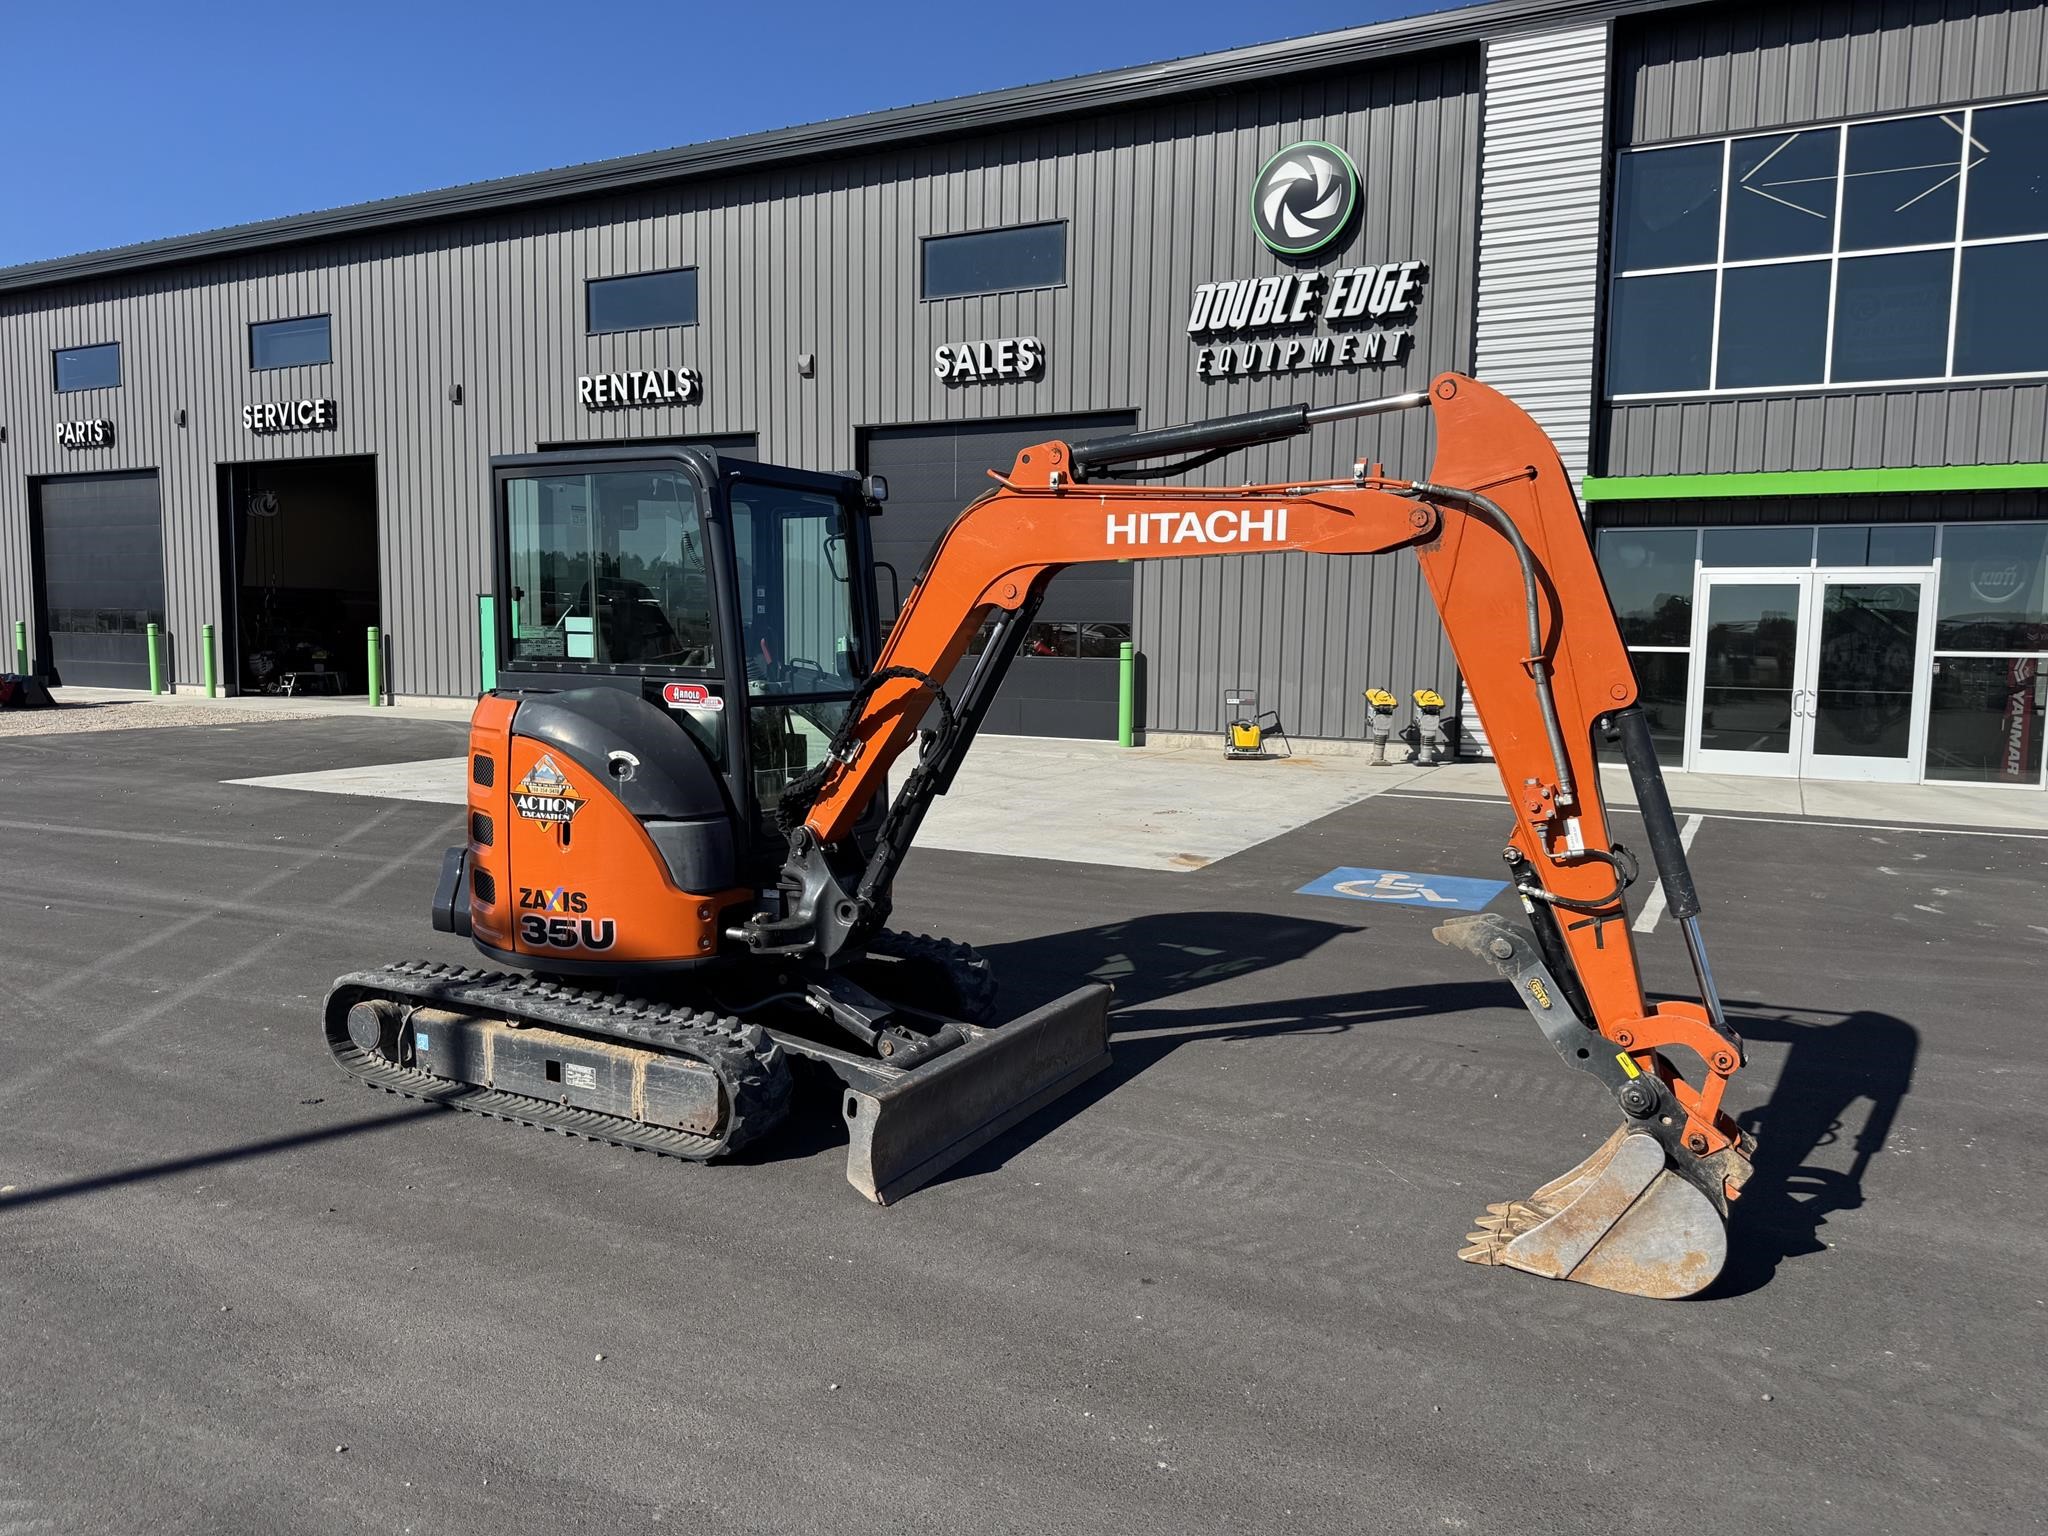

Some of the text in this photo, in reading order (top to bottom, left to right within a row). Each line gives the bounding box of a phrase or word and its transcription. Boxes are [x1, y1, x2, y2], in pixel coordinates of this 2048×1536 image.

[1187, 260, 1421, 332] DOUBLE EDGE
[934, 338, 1035, 378] SALES
[1196, 331, 1406, 373] EQUIPMENT
[578, 367, 691, 403] RENTALS
[56, 419, 103, 444] PARTS
[243, 399, 326, 430] SERVICE
[1106, 508, 1288, 545] HITACHI
[673, 686, 700, 700] ARNOLD
[2007, 690, 2026, 776] YANMAR
[517, 794, 576, 813] ACTION
[519, 887, 588, 914] ZAXIS
[521, 914, 616, 951] 35U
